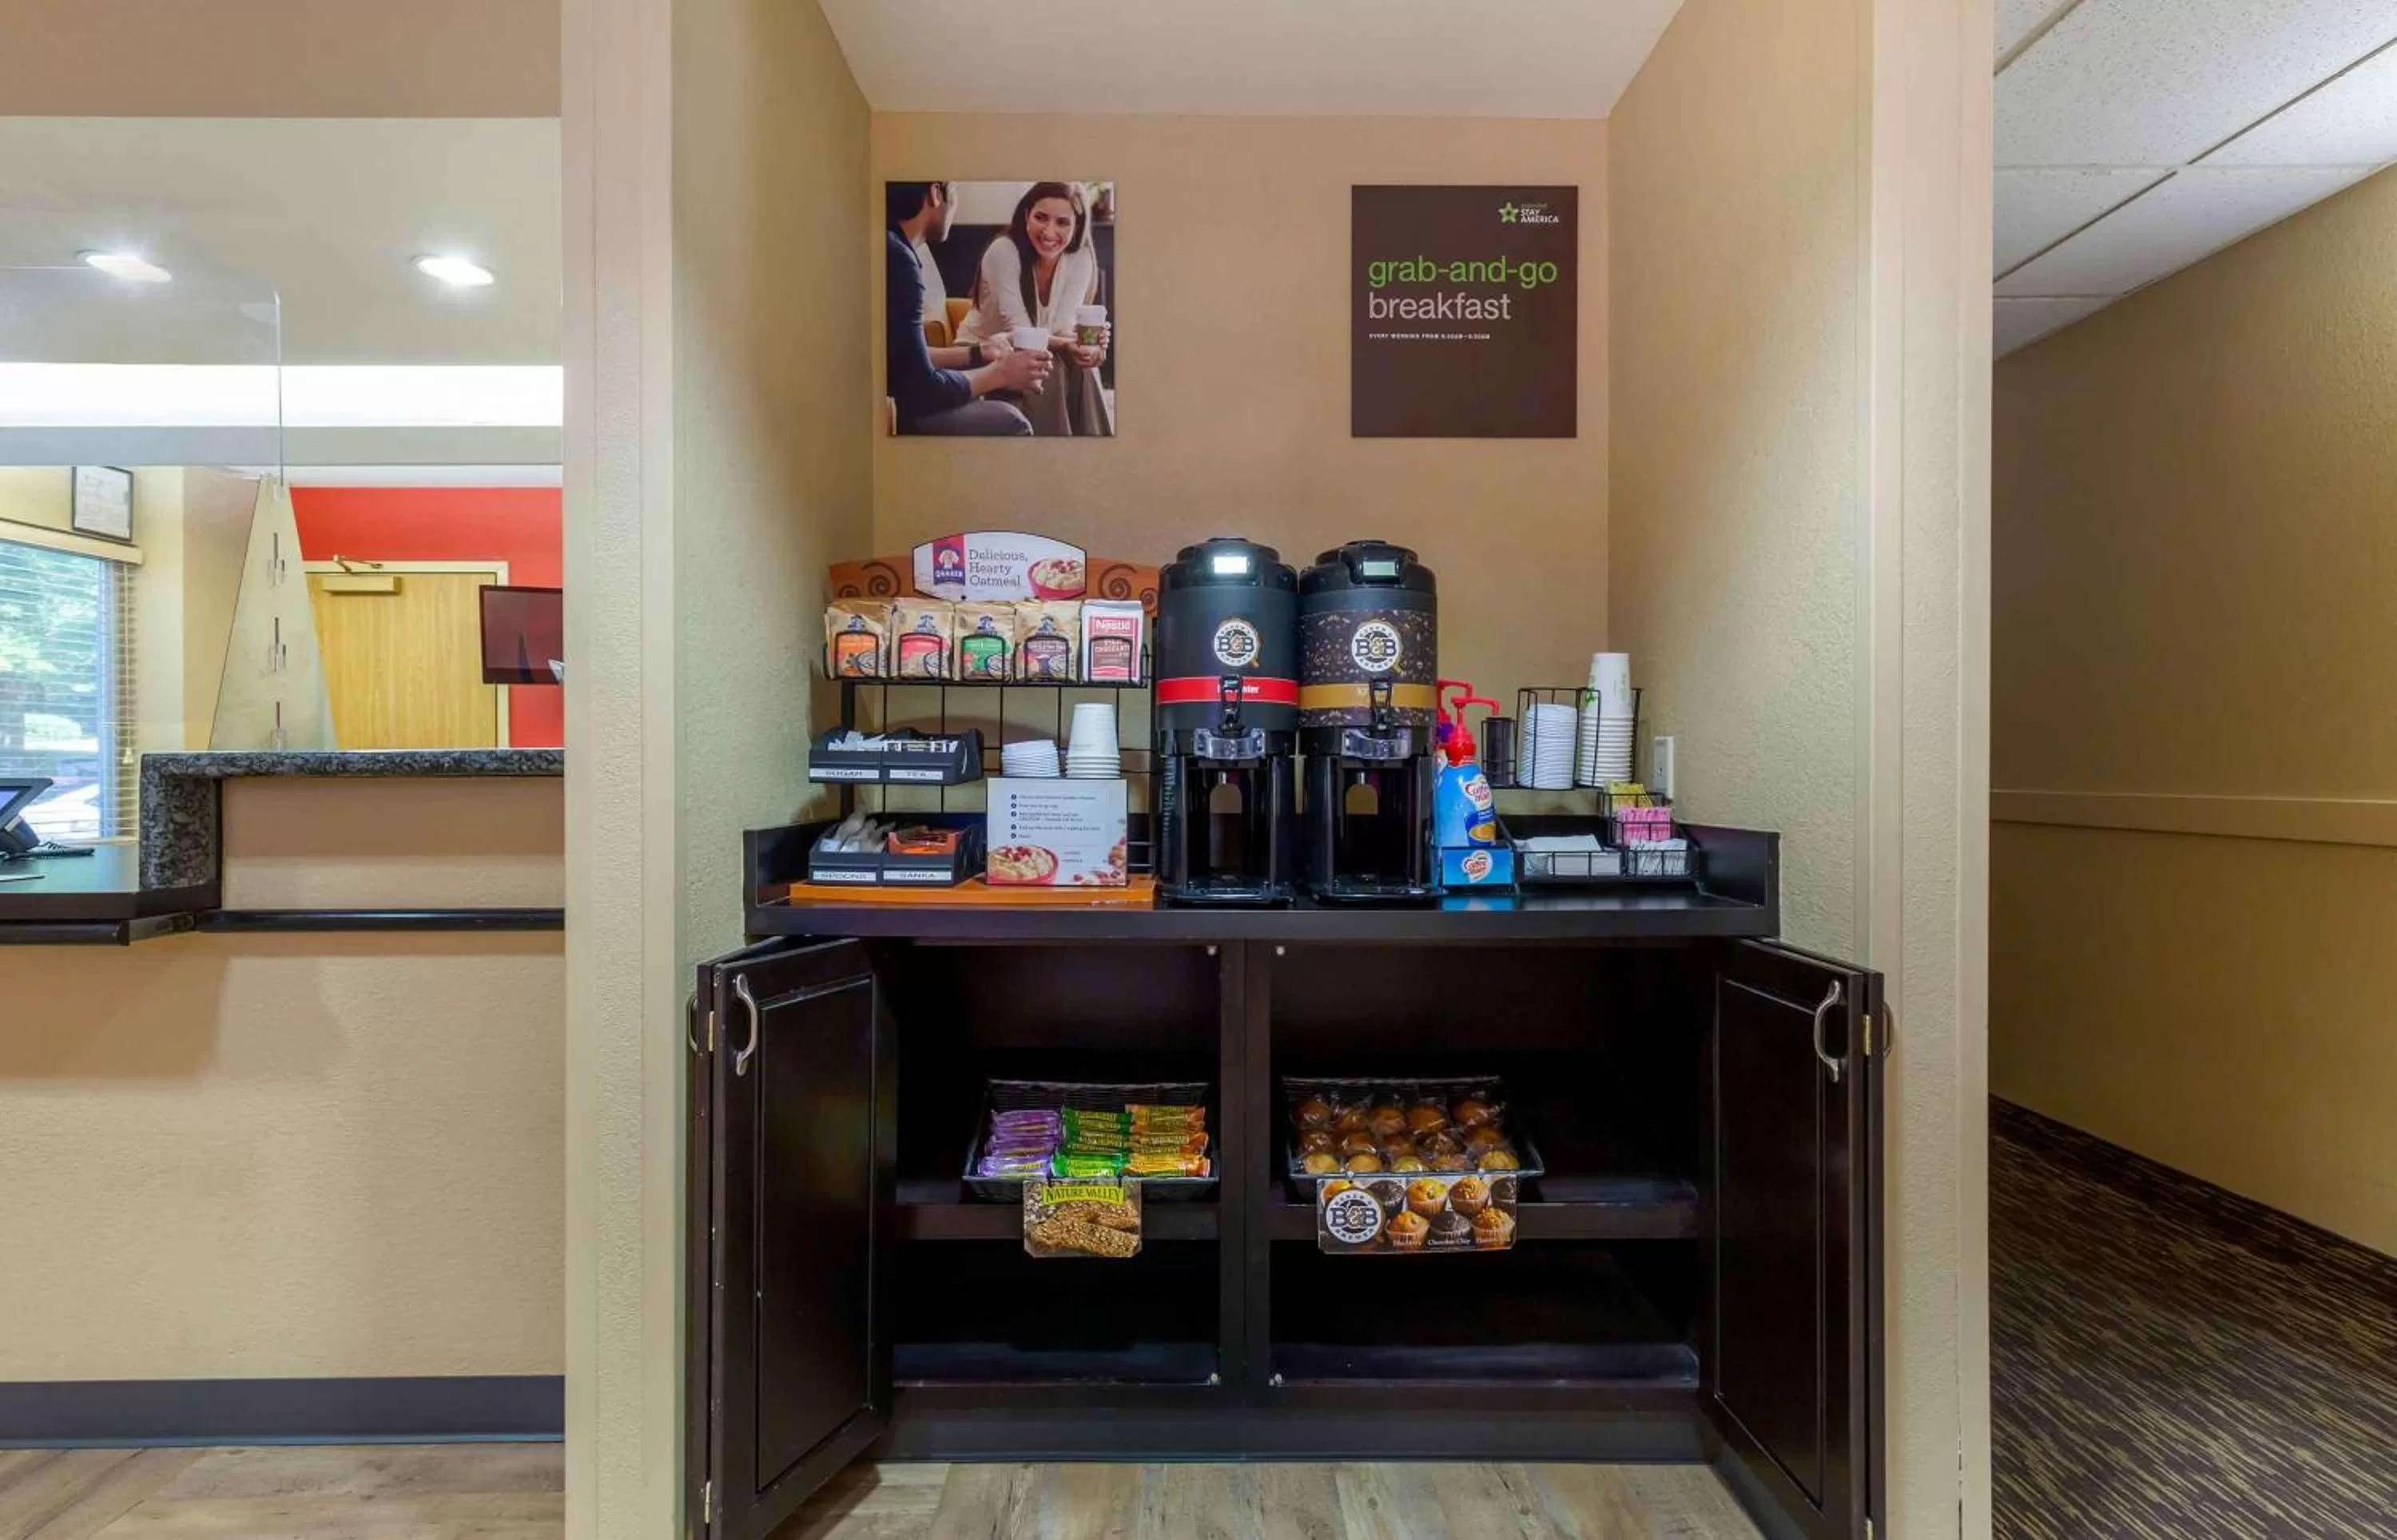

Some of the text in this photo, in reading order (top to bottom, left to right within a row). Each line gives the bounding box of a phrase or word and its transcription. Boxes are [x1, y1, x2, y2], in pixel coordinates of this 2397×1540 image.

[1368, 255, 1557, 289] grab-and-go
[1369, 292, 1512, 320] breakfast
[968, 549, 1028, 562] Delicious,
[968, 562, 1012, 574] Hearty
[968, 575, 1021, 587] Oatmeal
[1046, 1187, 1120, 1203] NATURE VALLEY
